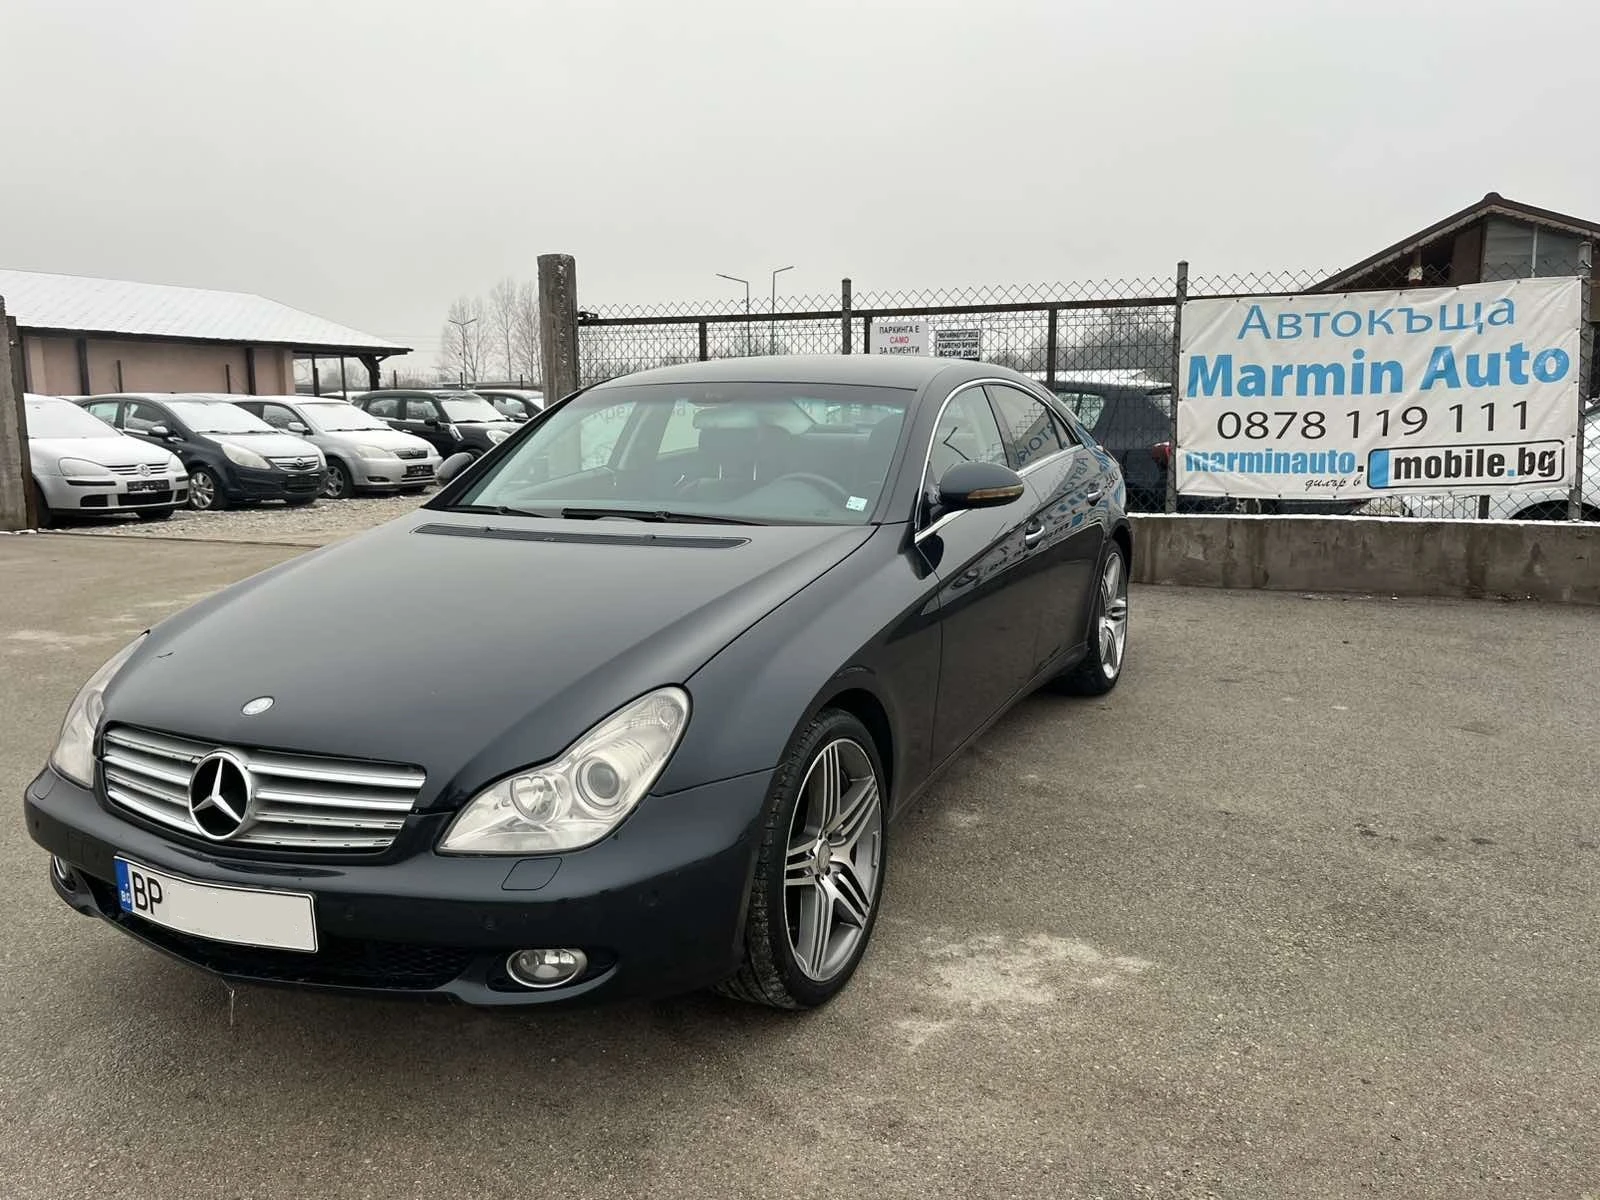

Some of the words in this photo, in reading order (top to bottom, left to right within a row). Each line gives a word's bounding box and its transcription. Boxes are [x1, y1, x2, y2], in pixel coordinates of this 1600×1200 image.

[879, 326, 914, 335] ПАРКИНГА
[914, 325, 920, 333] Е
[889, 336, 909, 344] САМО
[879, 346, 889, 355] ЗА
[889, 346, 920, 355] КЛИЕНТИ
[1186, 348, 1404, 398] Marmin
[1420, 342, 1571, 391] Auto
[1216, 410, 1327, 440] 0878
[1346, 405, 1428, 438] 119
[1449, 400, 1528, 433] 111
[1393, 447, 1556, 480] mobile.bg
